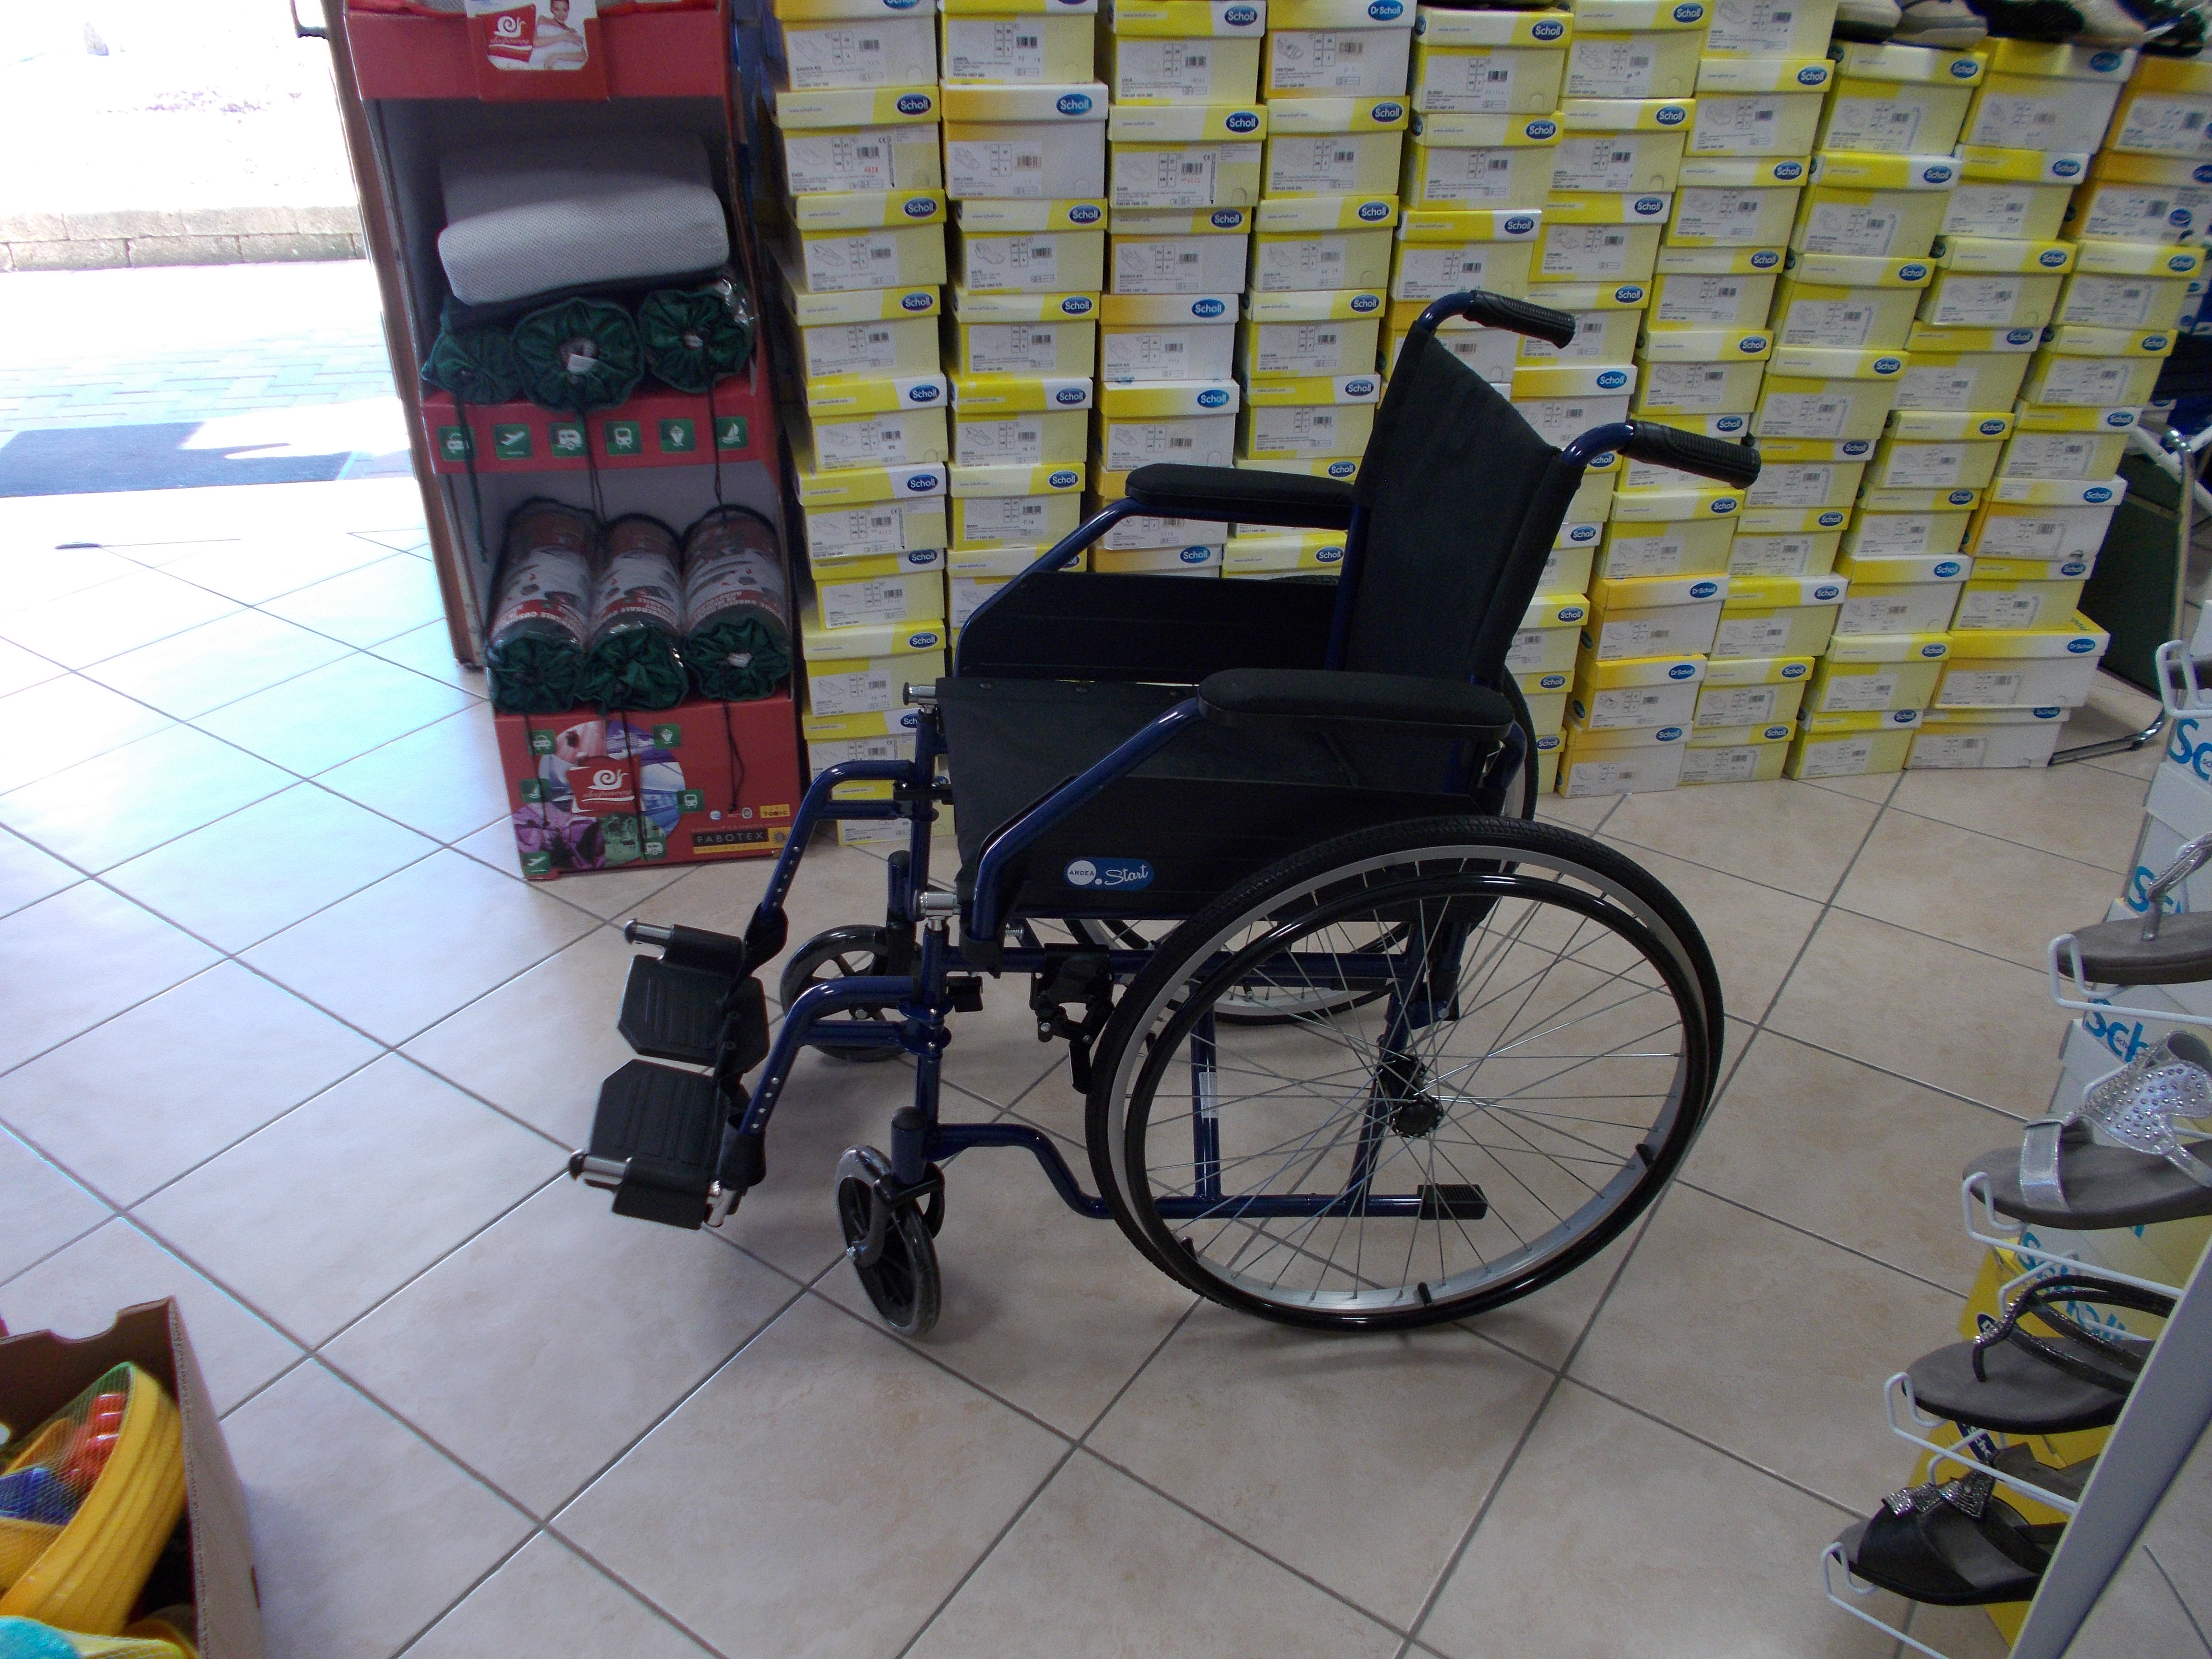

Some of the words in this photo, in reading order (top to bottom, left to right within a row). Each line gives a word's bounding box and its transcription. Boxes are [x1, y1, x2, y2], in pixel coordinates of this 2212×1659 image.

[1380, 5, 1401, 14] Scholl
[1677, 8, 1700, 18] Scholl
[1228, 11, 1254, 21] Scholl
[1536, 25, 1561, 35] Scholl
[1954, 64, 1976, 73] Scholl
[1801, 72, 1825, 80] Scholl
[902, 99, 929, 110] Scholl
[1060, 99, 1089, 110] Scholl
[1375, 108, 1399, 117] Scholl
[1659, 111, 1683, 120] Scholl
[1230, 118, 1256, 127] Scholl
[1529, 126, 1554, 134] Scholl
[1777, 167, 1800, 175] Scholl
[1927, 170, 1950, 179] Scholl
[908, 203, 934, 212] Scholl
[1362, 207, 1386, 216] Scholl
[1073, 209, 1097, 218] Scholl
[1215, 215, 1239, 223] Scholl
[1755, 255, 1776, 263] Scholl
[2043, 254, 2063, 263] Scholl
[905, 297, 930, 306] Scholl
[1065, 301, 1089, 310] Scholl
[1195, 304, 1223, 313] Scholl
[1743, 340, 1764, 349] Scholl
[1600, 376, 1624, 384] Scholl
[913, 389, 938, 398] Scholl
[1060, 392, 1082, 400] Scholl
[1201, 394, 1226, 403] Scholl
[911, 475, 935, 487] Scholl
[1053, 475, 1075, 484] Scholl
[1184, 550, 1208, 559] Scholl
[912, 636, 935, 645] Scholl
[1659, 730, 1681, 738] Scholl
[697, 831, 763, 843] FABOTEX
[1104, 865, 1148, 885] Start
